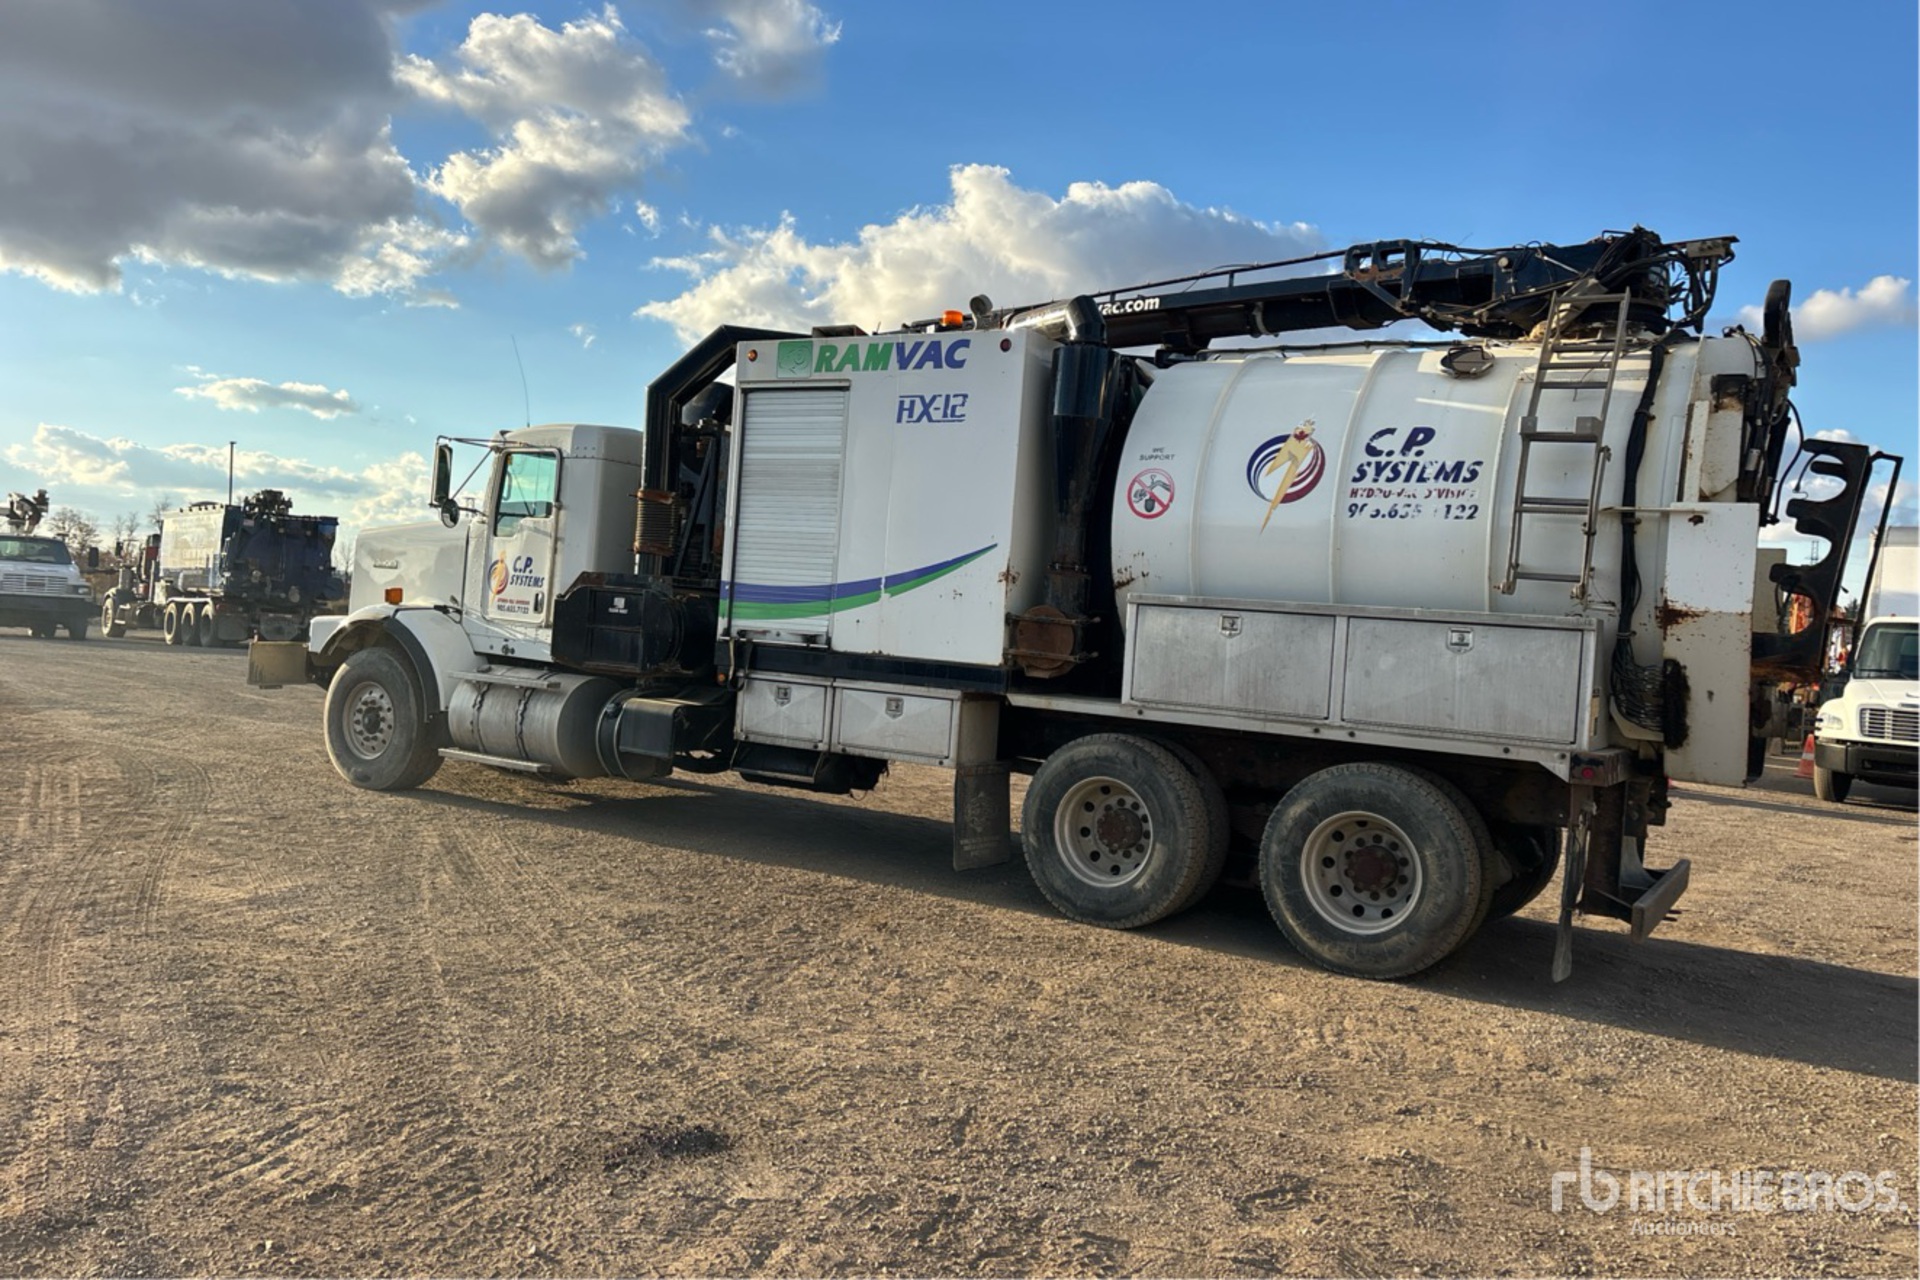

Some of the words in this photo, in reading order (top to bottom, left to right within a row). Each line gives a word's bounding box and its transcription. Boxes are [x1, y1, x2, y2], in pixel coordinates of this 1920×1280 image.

[814, 339, 971, 373] RAMVAC
[896, 393, 969, 423] HX-12
[1364, 426, 1436, 457] C.P.
[1351, 460, 1484, 484] SYSTEMS
[513, 555, 533, 574] C.P.
[510, 574, 545, 589] SYSTEMS
